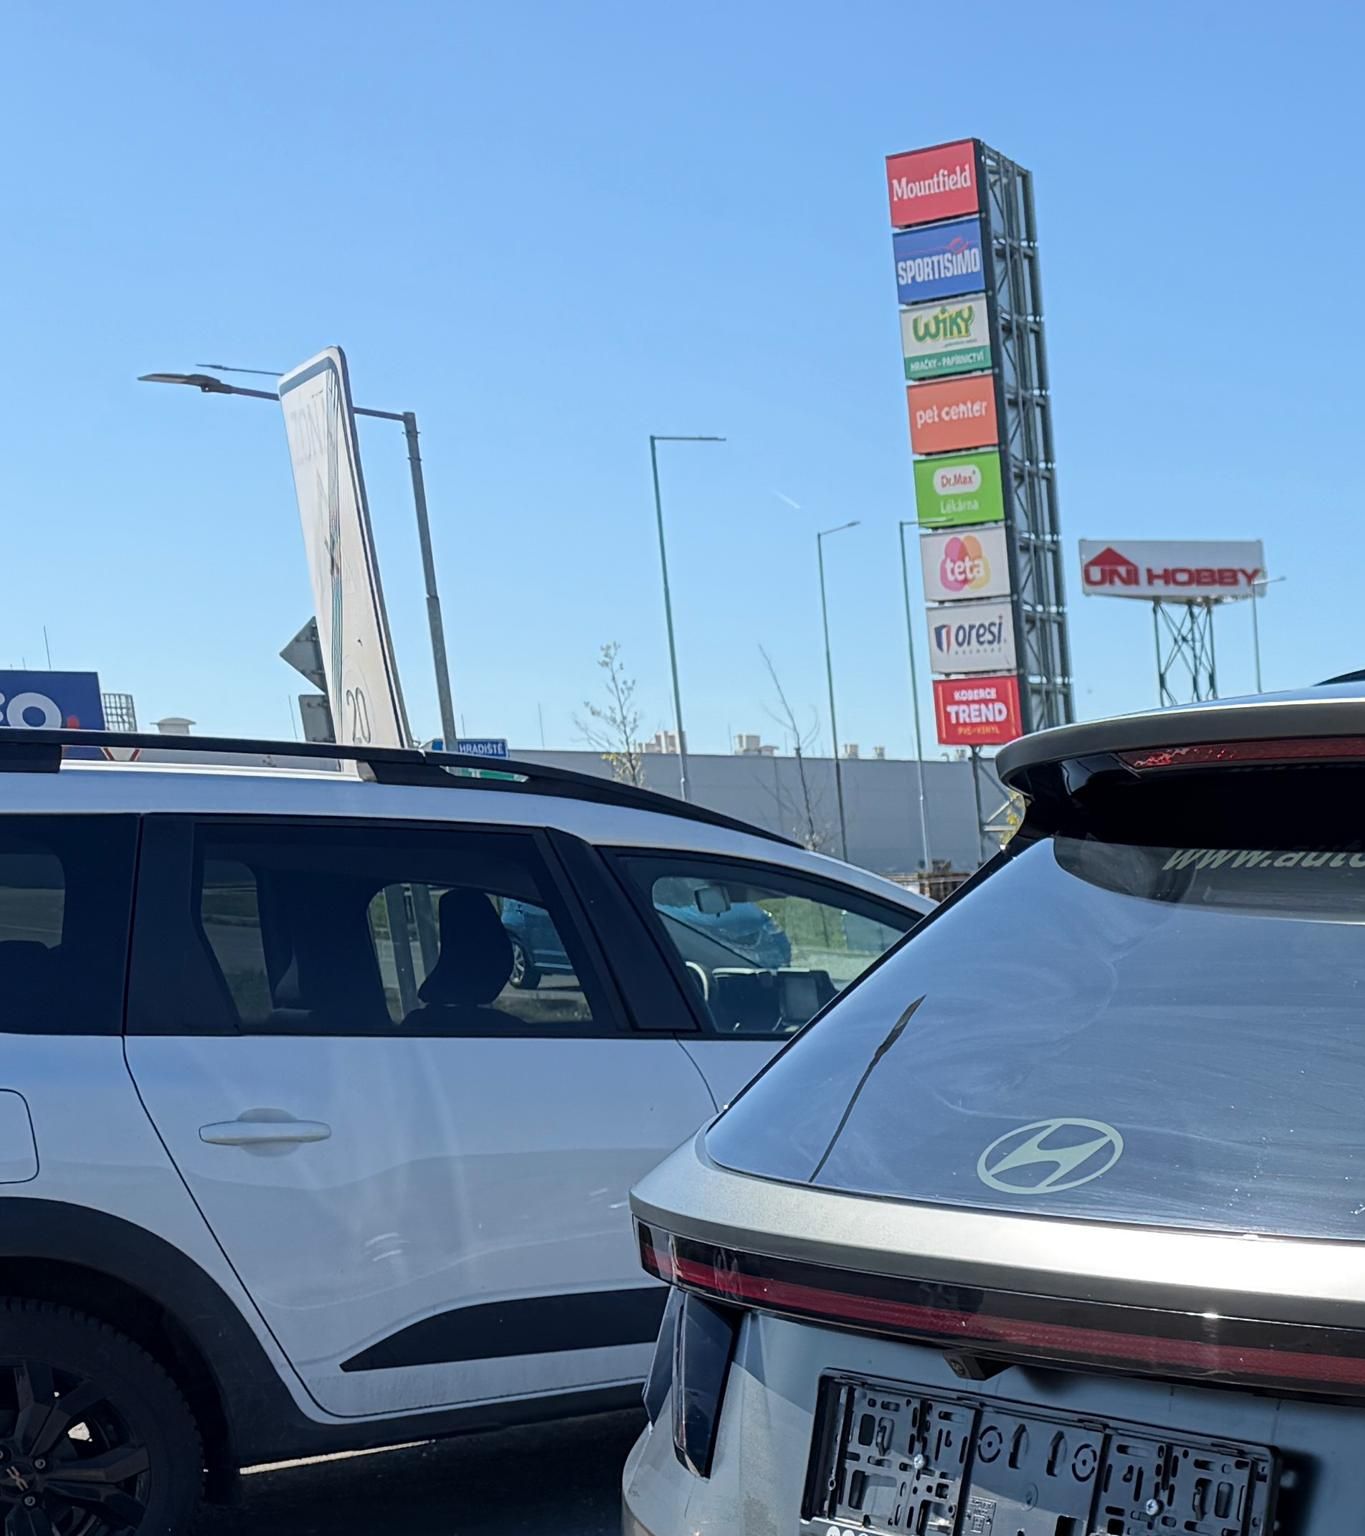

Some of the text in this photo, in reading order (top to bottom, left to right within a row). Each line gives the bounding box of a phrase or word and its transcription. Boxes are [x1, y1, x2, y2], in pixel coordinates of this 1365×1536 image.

[891, 164, 971, 201] Mountfield
[897, 248, 981, 285] SPORTISIMO
[916, 400, 988, 428] pet center
[945, 557, 985, 582] teta
[1083, 564, 1261, 587] UNI HOBBY
[955, 615, 1004, 648] oresi
[946, 702, 1008, 725] TREND
